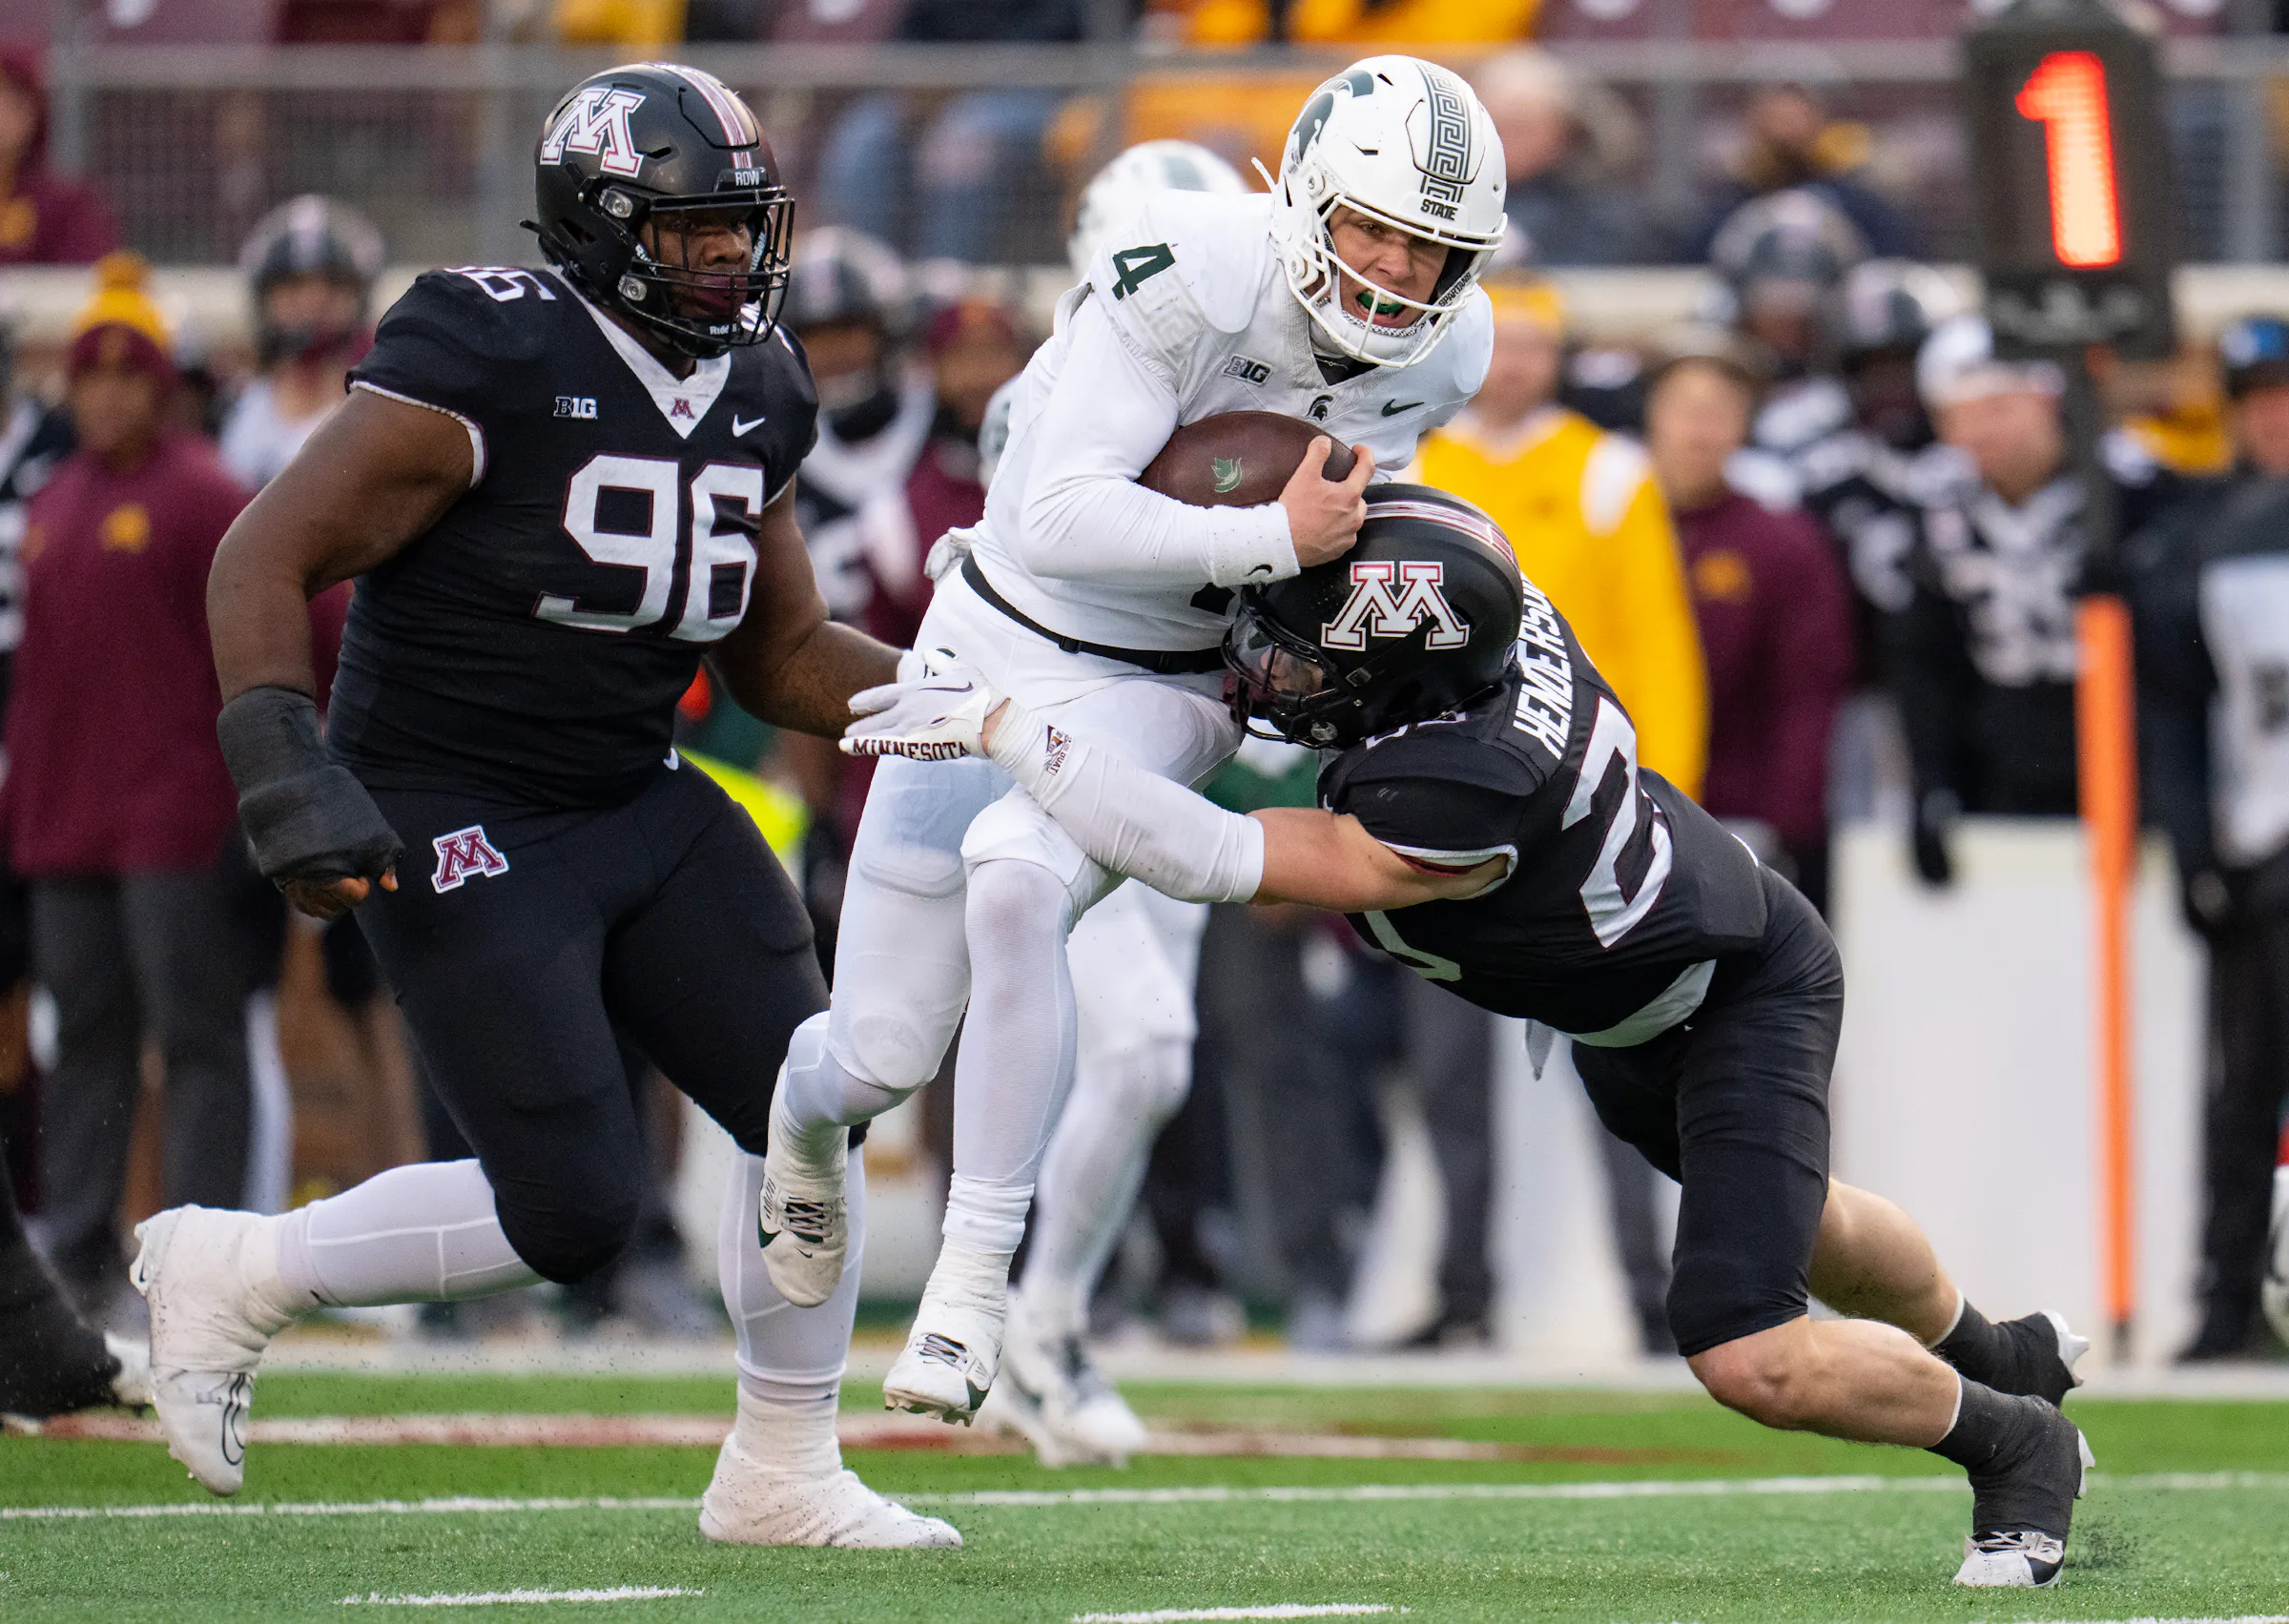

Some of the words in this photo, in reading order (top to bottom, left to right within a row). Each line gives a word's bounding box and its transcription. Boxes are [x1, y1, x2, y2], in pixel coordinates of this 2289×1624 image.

[539, 87, 647, 178] M
[2014, 51, 2122, 271] 1
[734, 172, 760, 186] ROW
[1420, 198, 1458, 220] STATE
[1111, 242, 1177, 301] 4
[1438, 272, 1472, 307] SPARTANS
[670, 397, 695, 420] M
[530, 450, 766, 644] 96
[1321, 561, 1470, 651] M
[853, 737, 971, 763] MINNESOTA
[1561, 691, 1673, 950] 2
[431, 825, 509, 894] M
